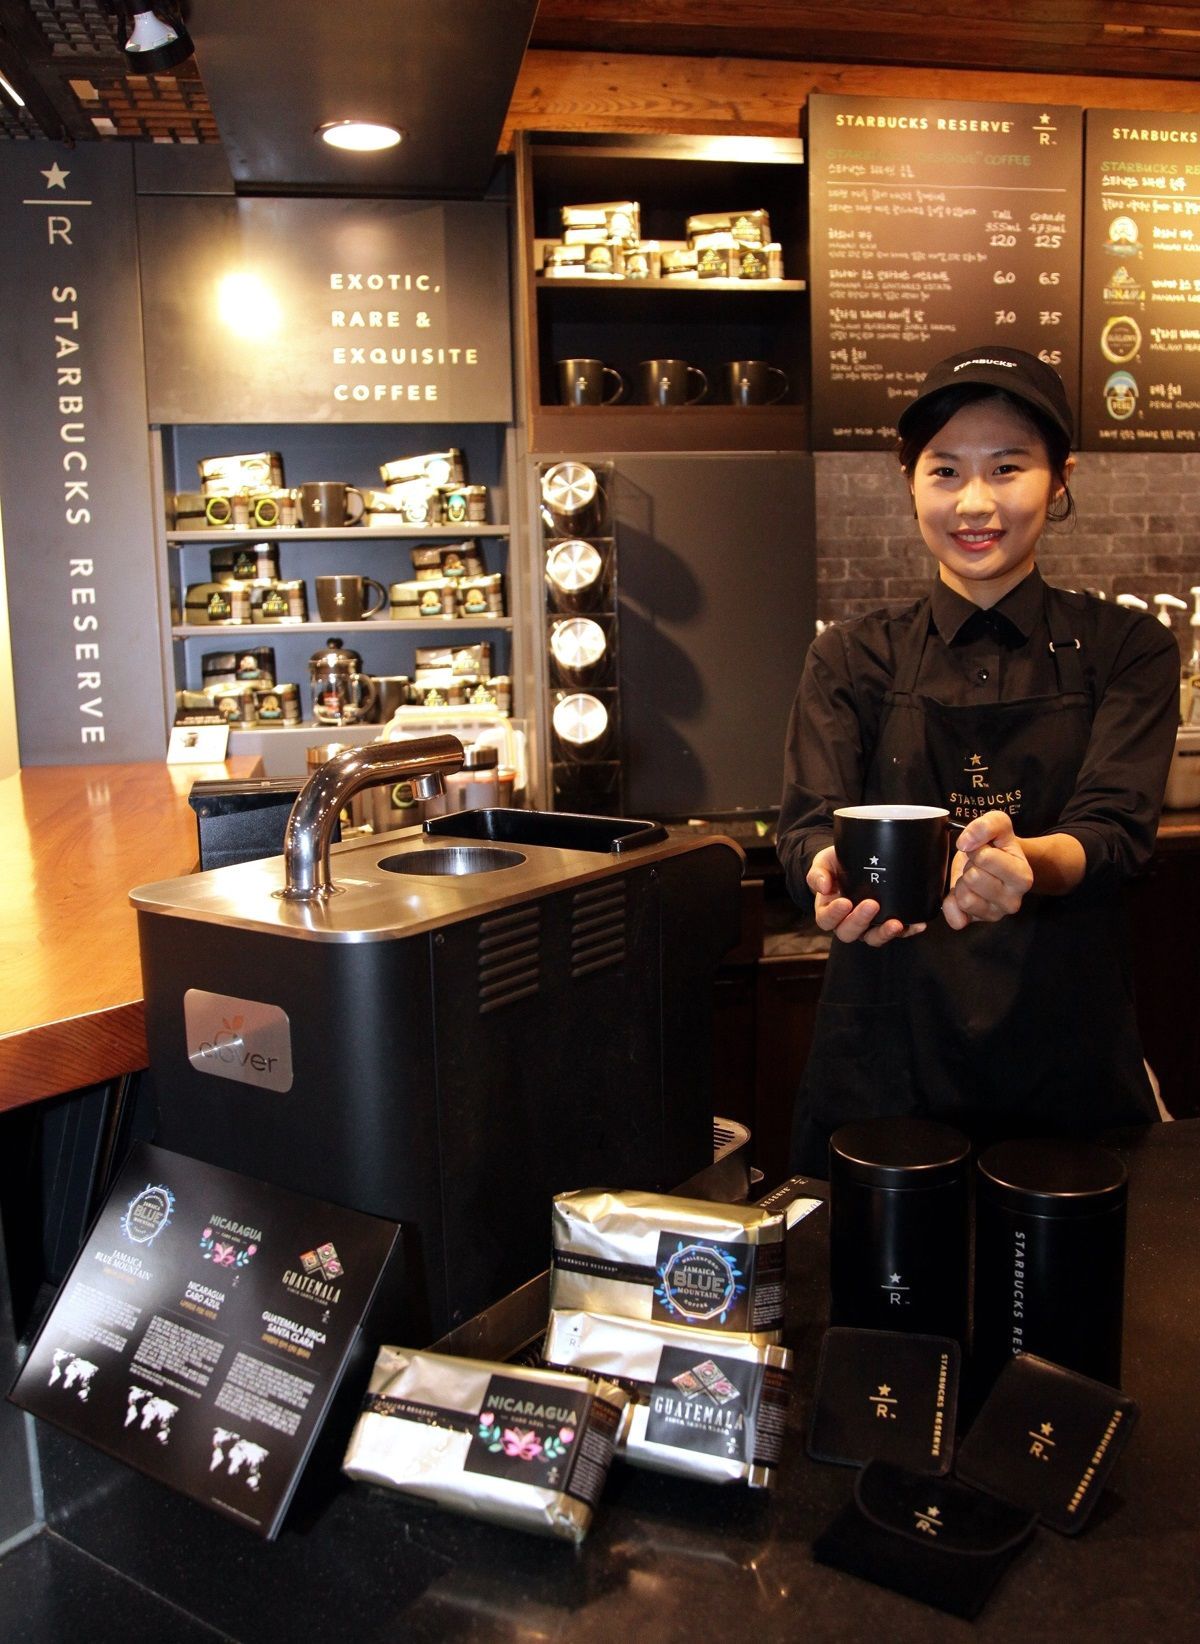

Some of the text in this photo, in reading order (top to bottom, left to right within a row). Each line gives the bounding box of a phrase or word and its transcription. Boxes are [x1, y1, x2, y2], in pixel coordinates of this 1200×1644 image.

[836, 114, 929, 130] STARBUCKS
[1112, 128, 1199, 143] STARBUCKS
[1101, 161, 1178, 174] STARBUCKS
[47, 215, 73, 245] R
[330, 273, 441, 293] EXOTIC,
[331, 310, 431, 328] RARE &
[333, 347, 478, 364] EXQUISITE
[333, 384, 438, 401] COFFEE
[51, 285, 106, 744] STARBUCKS RESERVE
[972, 774, 984, 788] R
[950, 789, 1022, 806] STARBUCKS
[870, 872, 880, 884] R
[209, 1214, 263, 1243] NICARAGUA
[683, 1265, 716, 1277] JAMAICA
[1012, 1231, 1025, 1319] STARBUCKS
[281, 1269, 342, 1304] GUATEMALA
[673, 1270, 726, 1294] BLUE
[890, 1292, 901, 1305] R
[486, 1394, 579, 1427] NICARAGUA
[876, 1403, 888, 1418] R
[931, 1353, 949, 1456] STARBUCKS RESERVE
[654, 1395, 744, 1432] GUATEMALA
